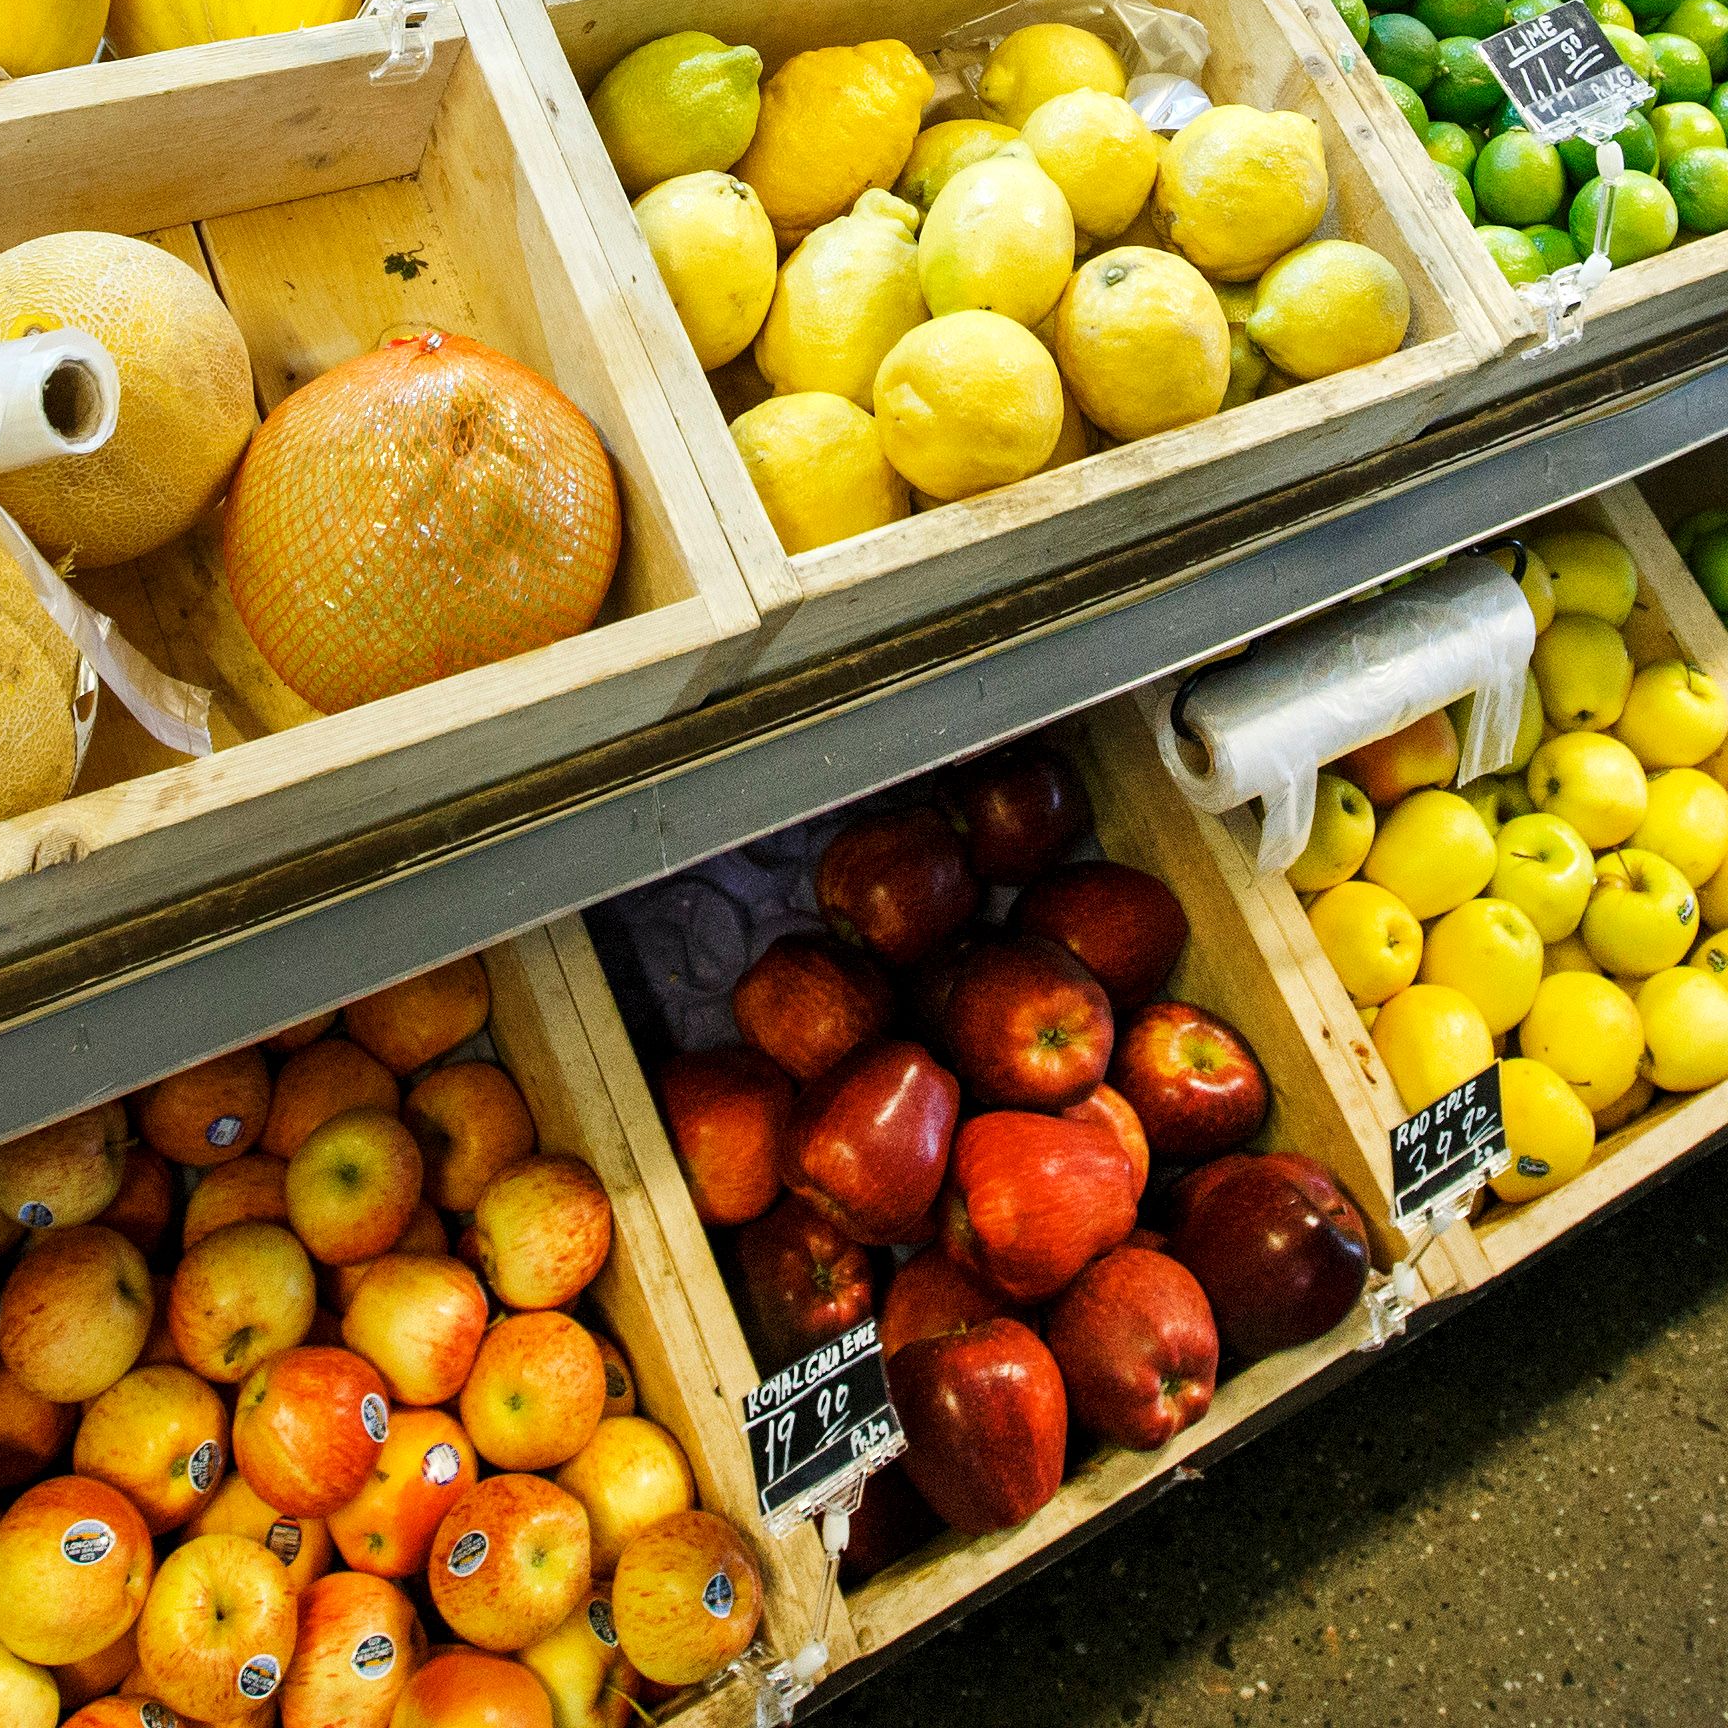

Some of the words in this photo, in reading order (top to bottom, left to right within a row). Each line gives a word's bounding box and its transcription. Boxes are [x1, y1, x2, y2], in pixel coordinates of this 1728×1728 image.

[1504, 15, 1557, 58] LIME
[1560, 34, 1583, 60] 90
[1435, 1080, 1477, 1125] EPLE
[1408, 1130, 1453, 1182] 39
[1461, 1106, 1487, 1142] 90
[747, 1364, 805, 1419] ROYAL
[764, 1410, 797, 1484] 19
[816, 1383, 850, 1428] 90
